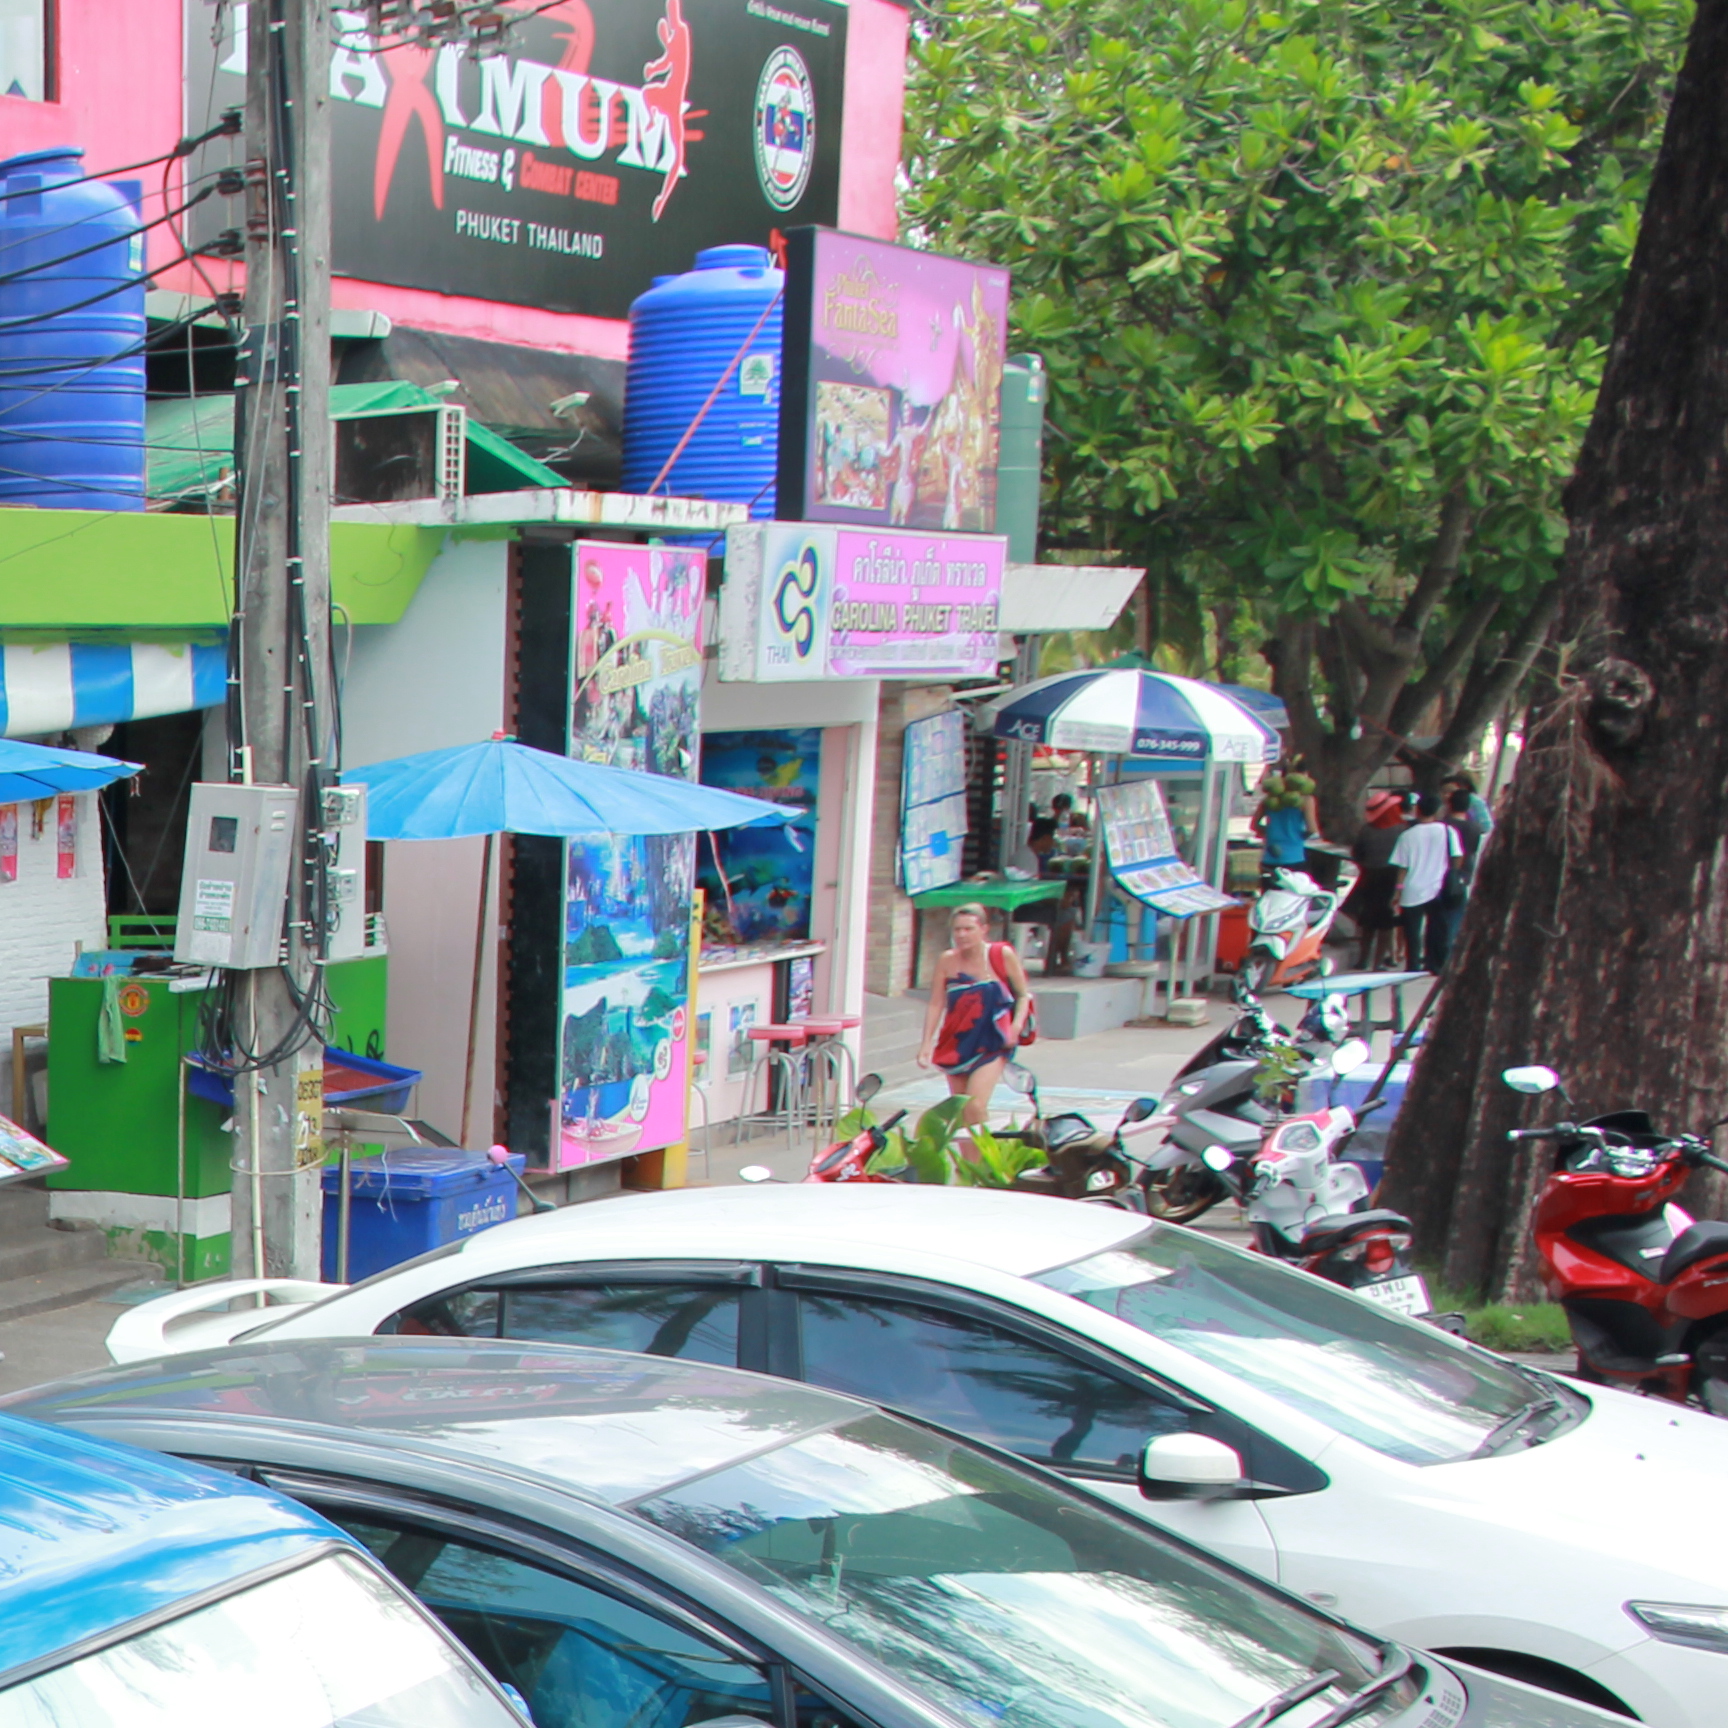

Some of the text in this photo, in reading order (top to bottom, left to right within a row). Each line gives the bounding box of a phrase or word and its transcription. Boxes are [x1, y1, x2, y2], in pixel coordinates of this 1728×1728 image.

[455, 208, 604, 260] PHUKET THAILAND
[830, 601, 999, 633] CAROLINA PHUKET TRAVEL
[767, 645, 790, 664] THAI
